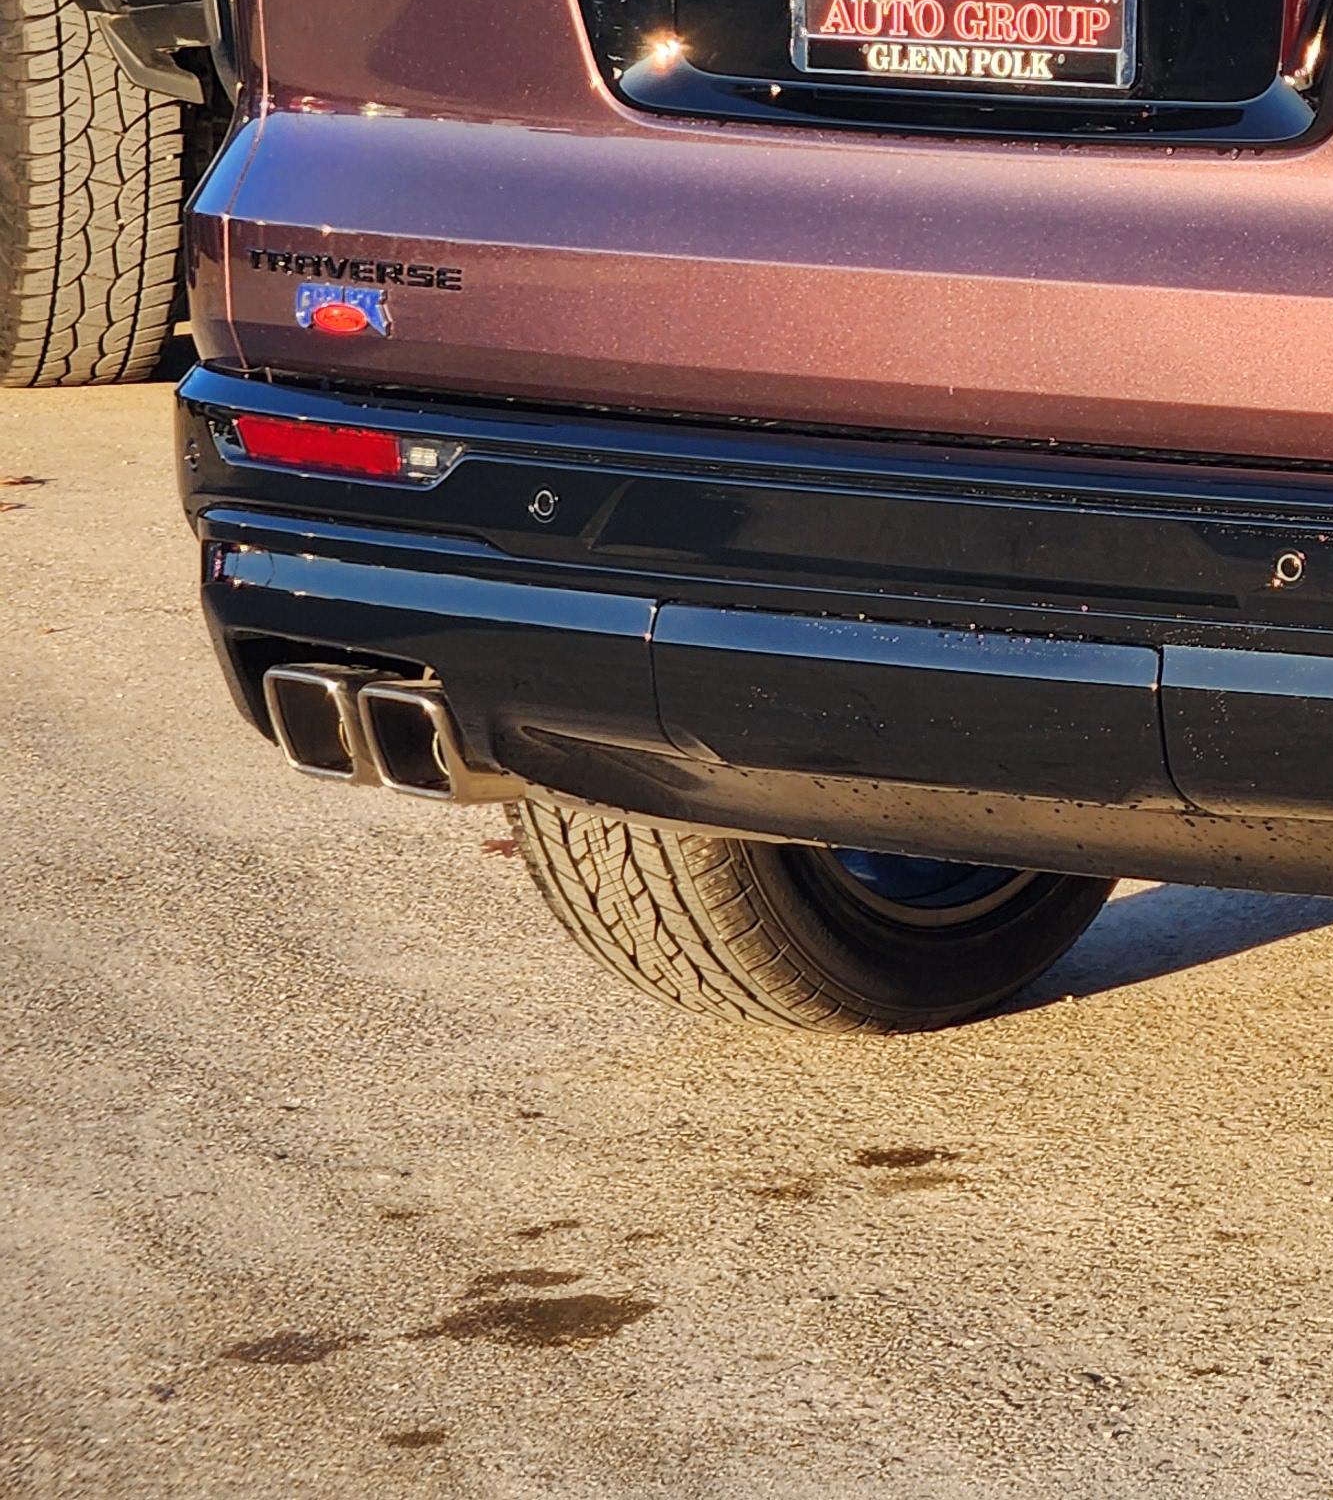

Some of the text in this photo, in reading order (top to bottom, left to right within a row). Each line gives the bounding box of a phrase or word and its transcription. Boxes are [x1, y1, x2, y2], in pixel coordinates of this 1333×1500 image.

[953, 0, 1111, 46] GROUP
[867, 43, 1054, 80] GLENN POLK
[246, 247, 464, 292] TRAVERSE
